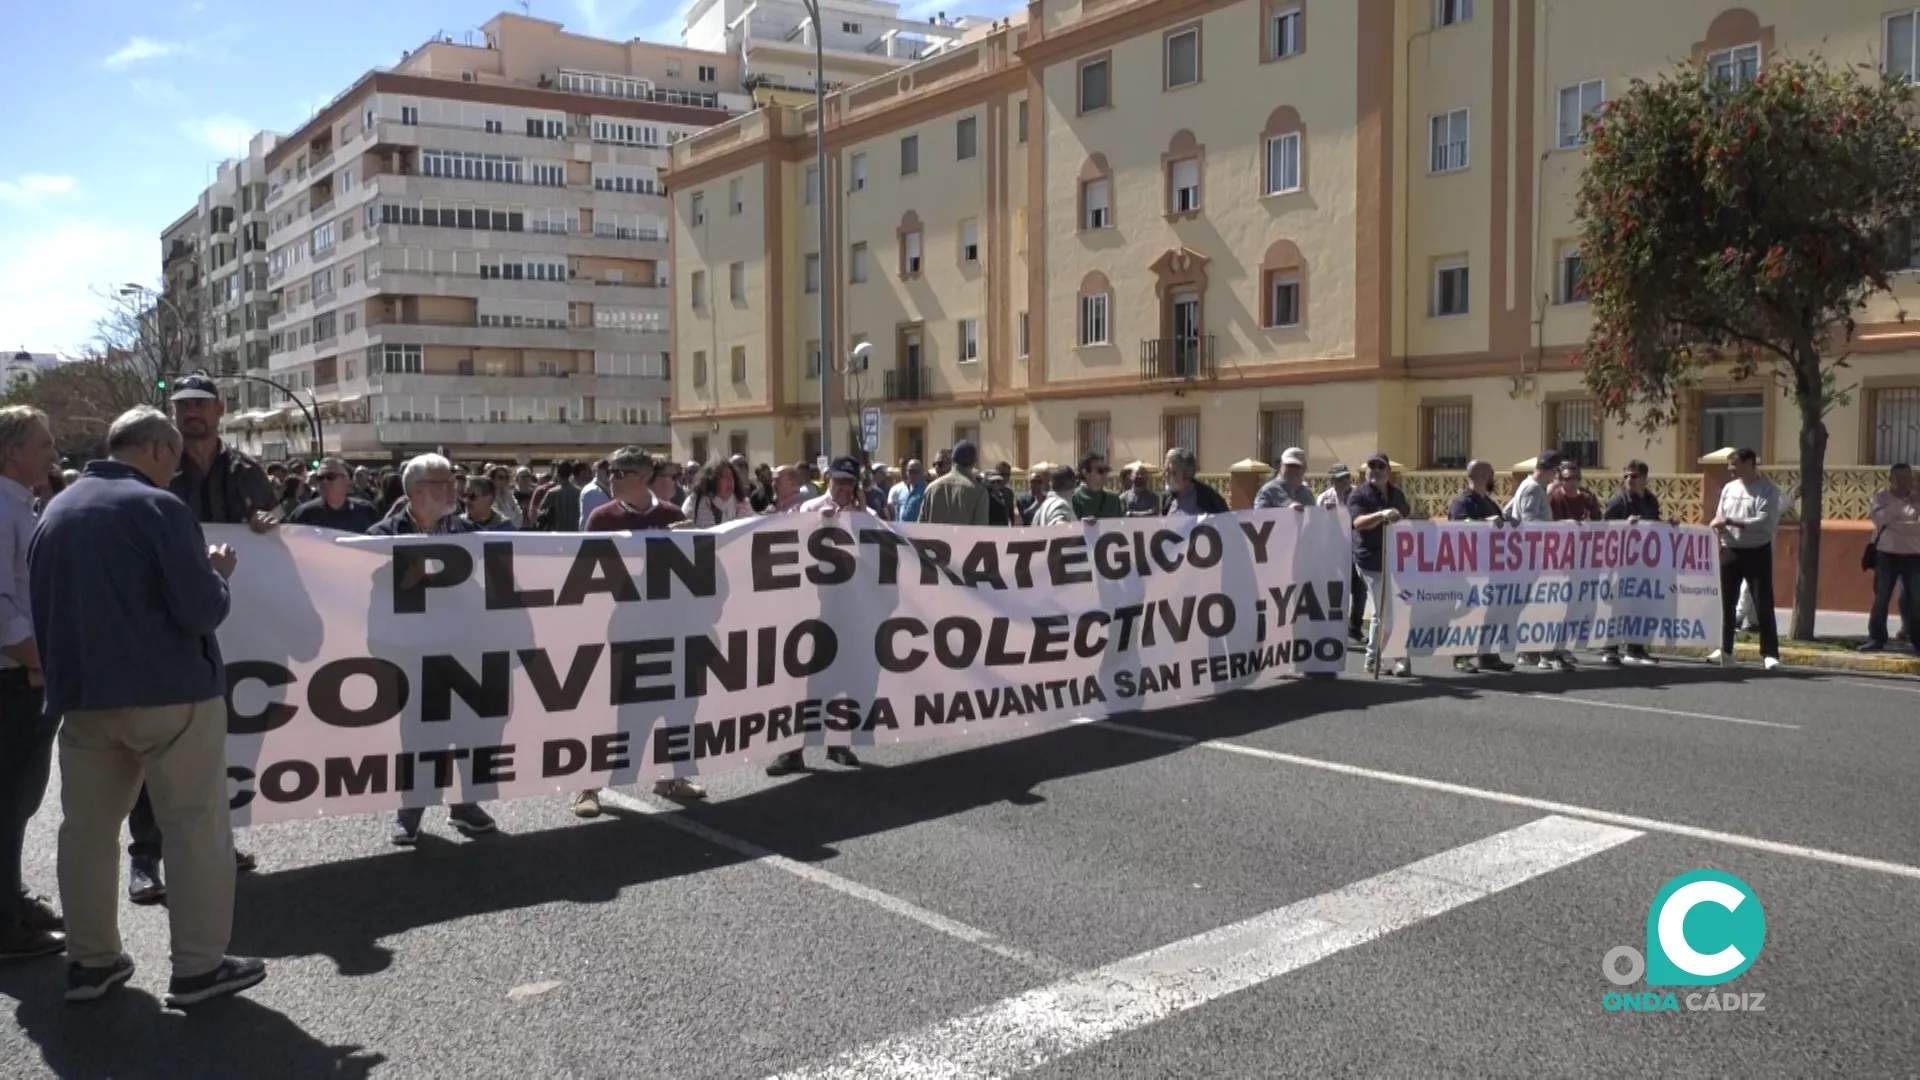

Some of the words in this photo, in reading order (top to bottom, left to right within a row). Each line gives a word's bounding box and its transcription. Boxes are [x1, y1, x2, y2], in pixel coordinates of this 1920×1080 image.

[393, 535, 716, 614] PLAN
[752, 524, 1222, 591] ESTRATEGICO
[1240, 521, 1276, 564] Y
[1396, 531, 1478, 572] PLAN
[1489, 530, 1660, 571] ESTRATEGICO
[1669, 532, 1710, 571] YA!!
[1416, 589, 1463, 602] Navantia
[1467, 580, 1573, 608] ASTILLERO
[1578, 579, 1614, 602] PTO.
[1406, 623, 1509, 649] NAVANTIA
[1516, 615, 1590, 645] COMITÉ
[1594, 619, 1616, 639] DE
[225, 618, 838, 734] CONVENIO
[875, 592, 1237, 674] COLECTIVO
[1256, 581, 1344, 643] ¡YA!
[227, 744, 516, 809] COMITE
[542, 732, 630, 778] DE
[653, 700, 899, 765] EMPRESA
[914, 677, 1106, 727] NAVANTIA
[1114, 664, 1181, 699] SAN
[1192, 637, 1344, 687] FERNANDO
